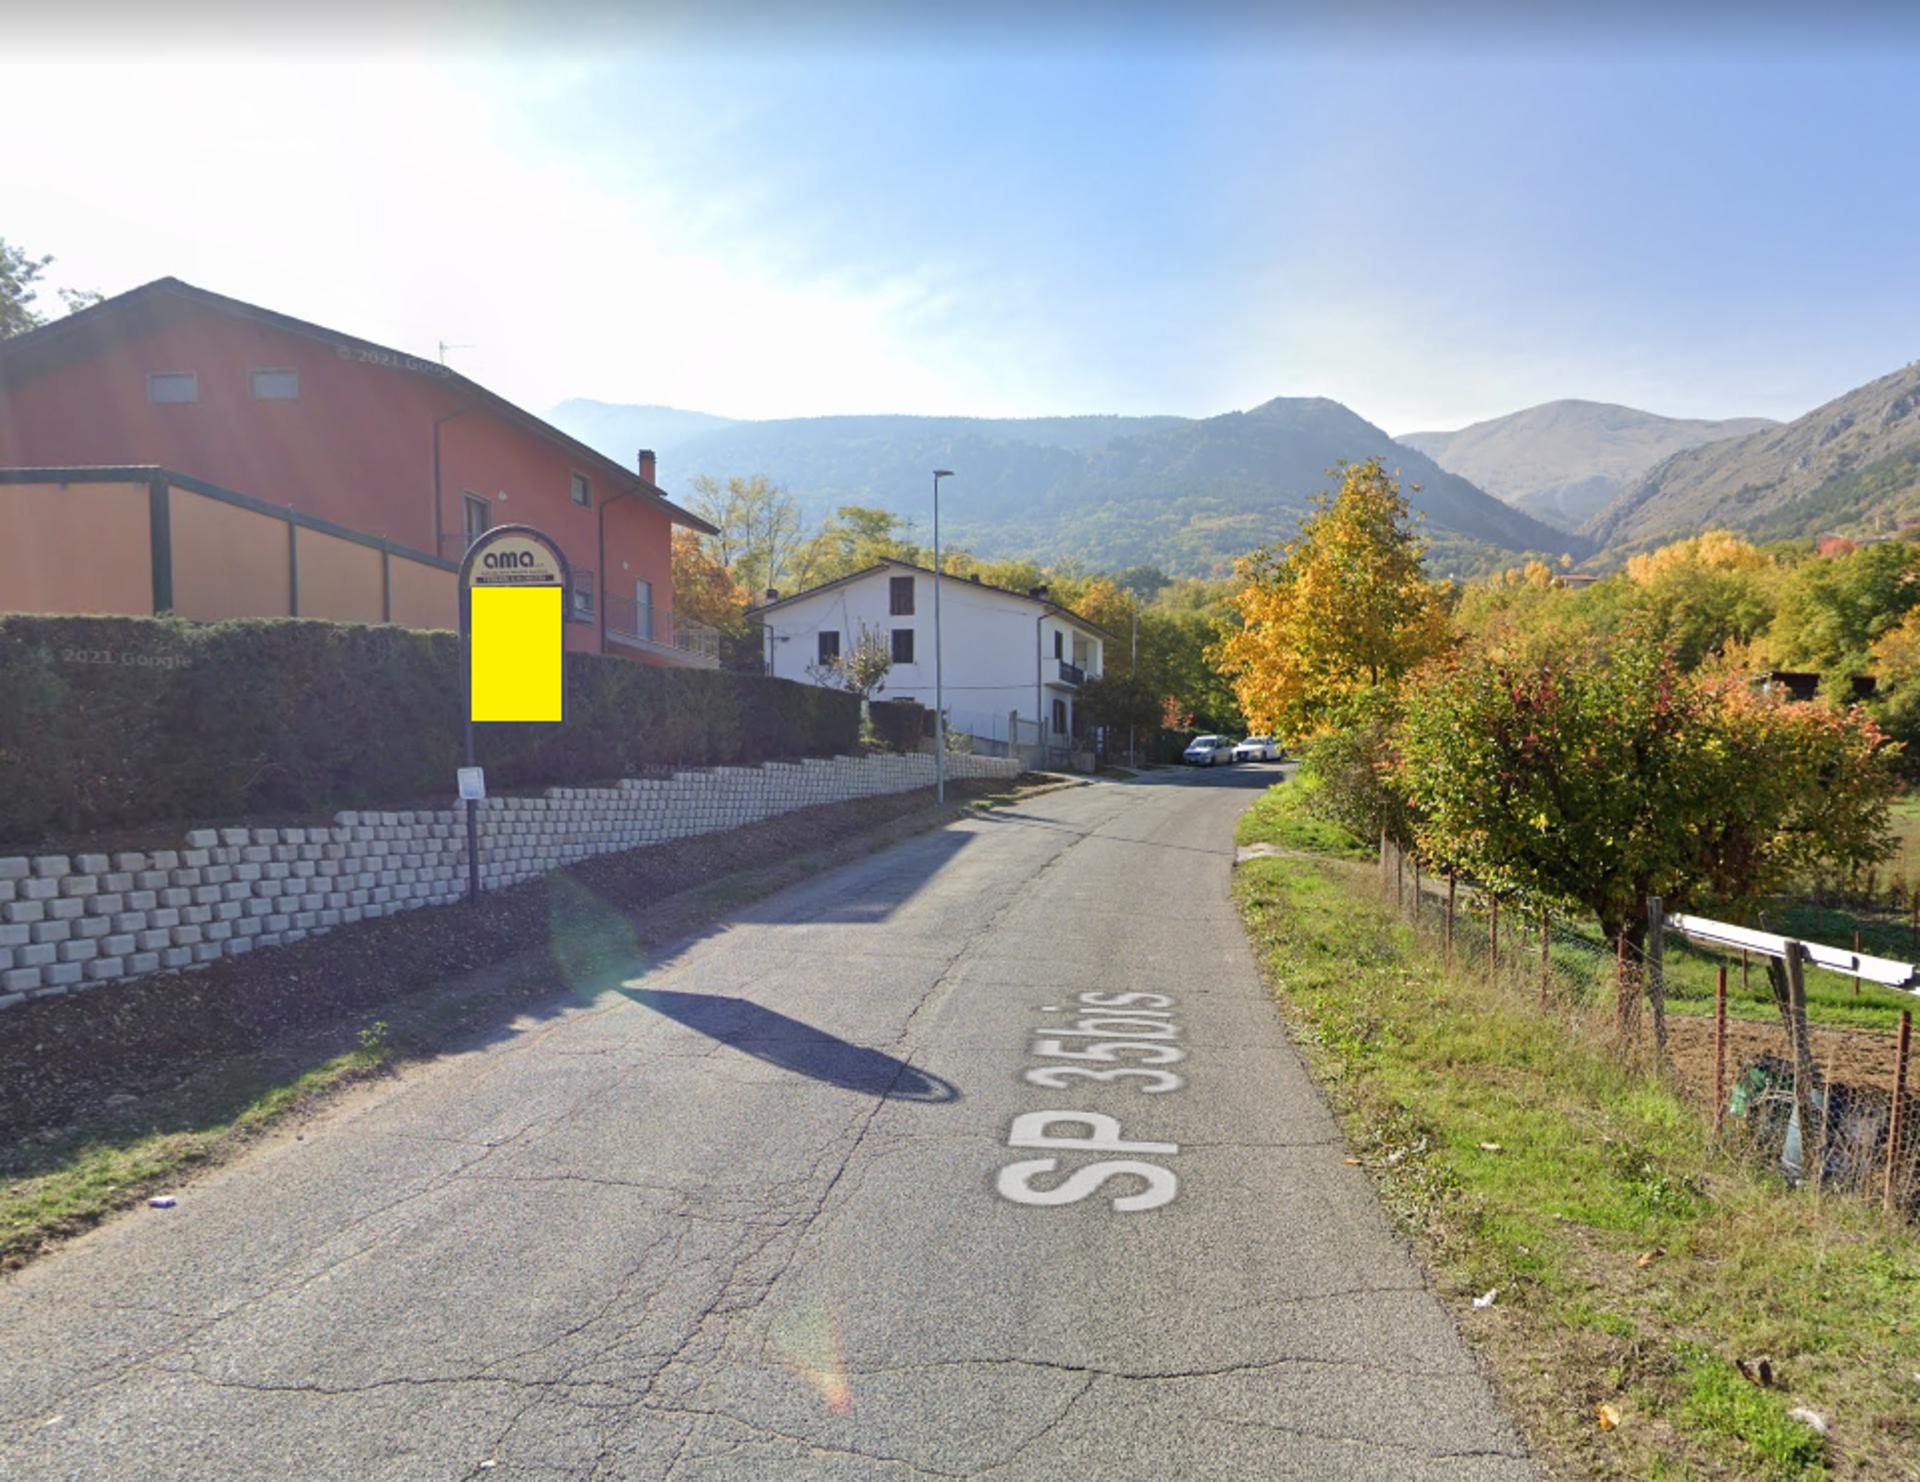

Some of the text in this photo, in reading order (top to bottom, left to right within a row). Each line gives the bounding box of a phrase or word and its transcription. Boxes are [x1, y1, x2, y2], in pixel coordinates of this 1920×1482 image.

[484, 551, 534, 568] ama
[997, 992, 1186, 1211] SP 35bis
